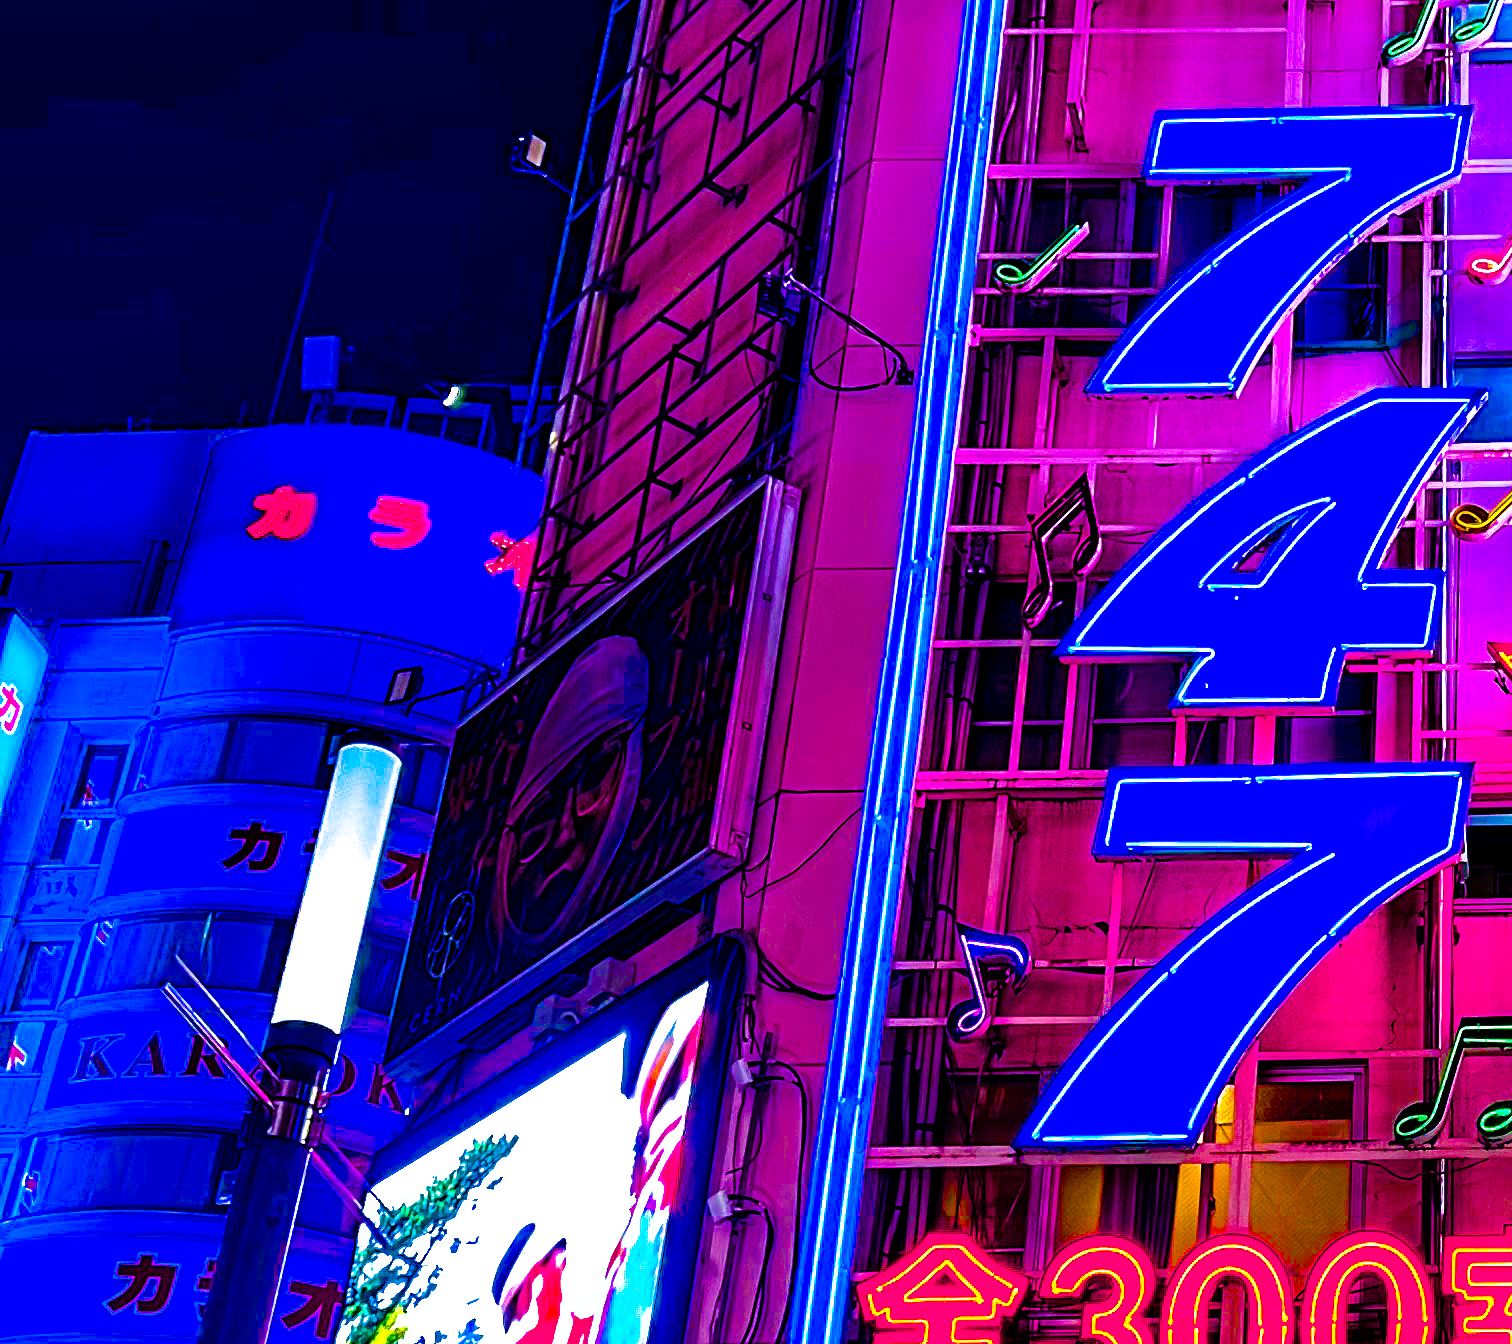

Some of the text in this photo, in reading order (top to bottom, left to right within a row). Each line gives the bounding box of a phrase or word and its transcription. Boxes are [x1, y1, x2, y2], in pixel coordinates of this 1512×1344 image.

[1014, 105, 1489, 1149] 747
[212, 821, 425, 901] カオ
[103, 1254, 344, 1339] カオ
